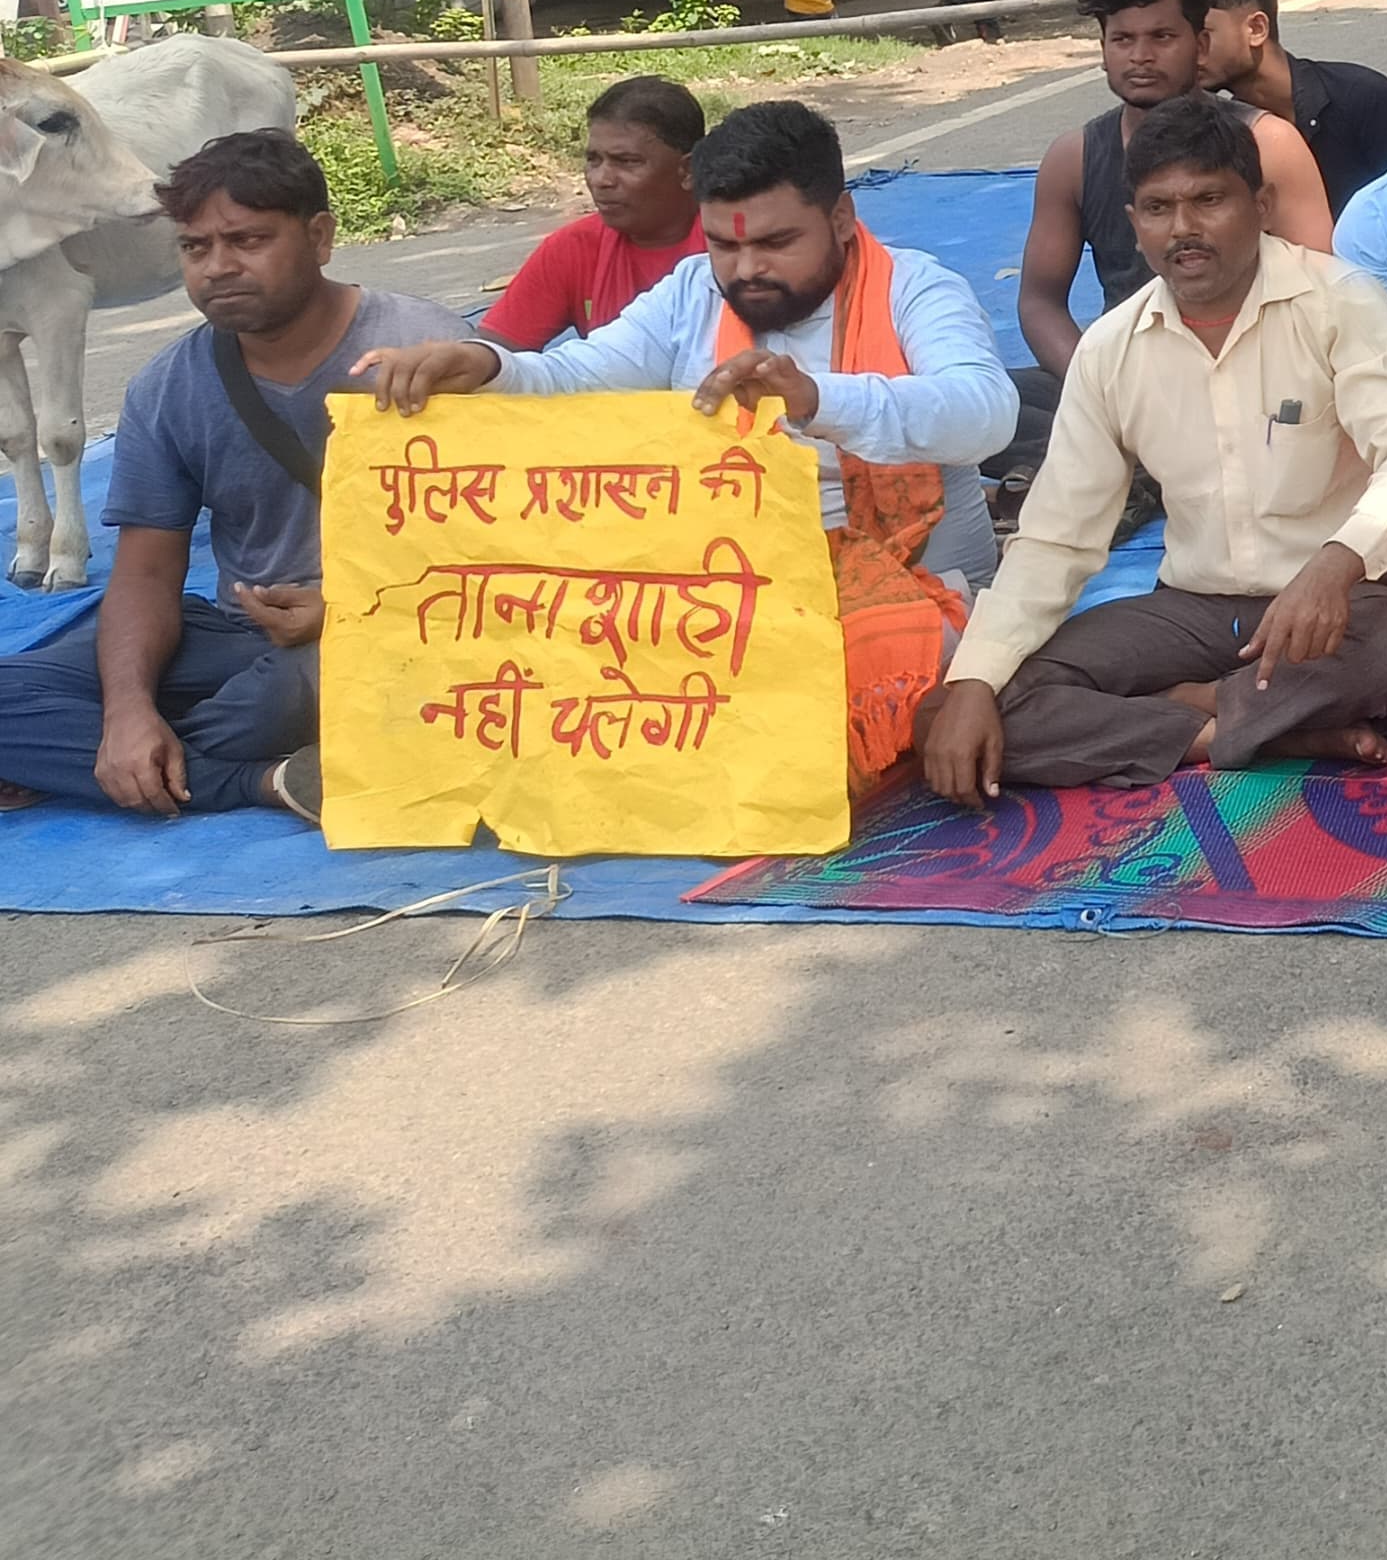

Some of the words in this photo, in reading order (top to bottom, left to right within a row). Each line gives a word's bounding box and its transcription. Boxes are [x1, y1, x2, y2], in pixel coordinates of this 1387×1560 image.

[369, 435, 506, 535] पुलिस
[521, 463, 680, 521] प्रशासन
[700, 446, 766, 517] की
[419, 660, 544, 759] नहीं
